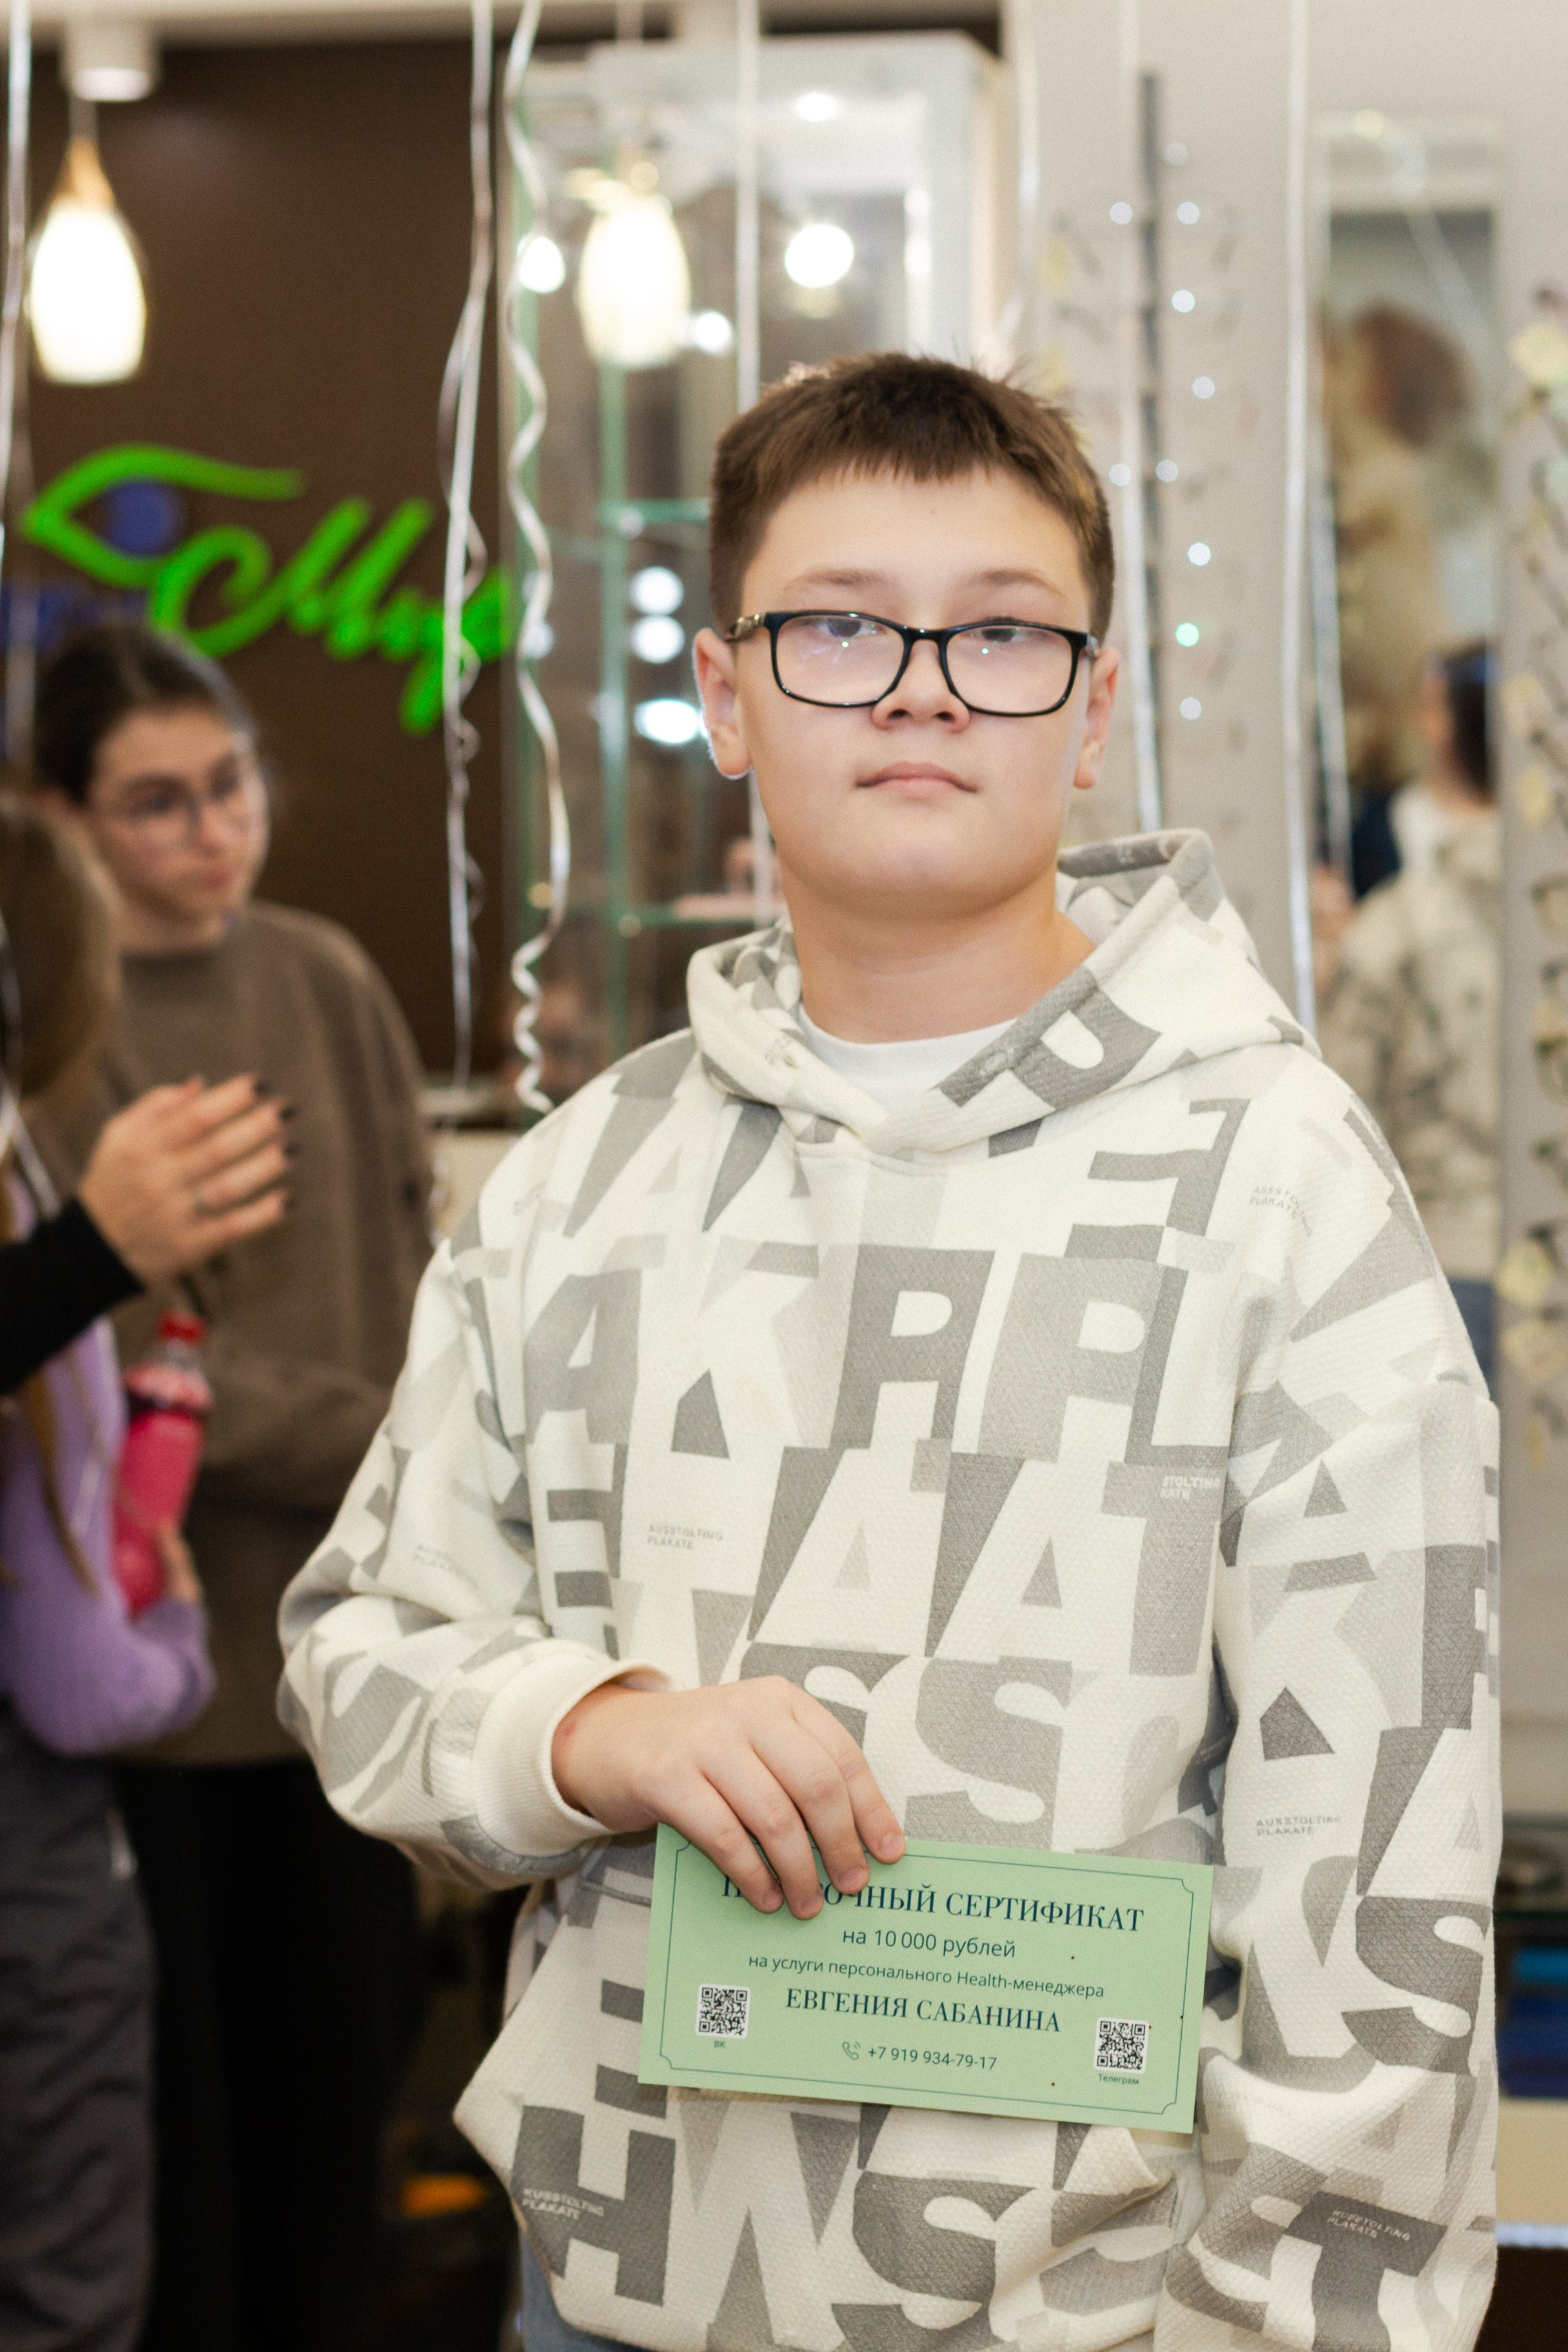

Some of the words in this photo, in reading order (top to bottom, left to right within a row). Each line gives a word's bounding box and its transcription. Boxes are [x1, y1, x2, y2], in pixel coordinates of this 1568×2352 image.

[946, 1892, 1144, 1932] СЕРТИФИКАТ
[842, 1930, 867, 1945] на
[943, 1936, 1016, 1959] рублей
[749, 1956, 768, 1968] на
[772, 1958, 824, 1974] услуги
[828, 1962, 952, 1984] персонального
[957, 1970, 1104, 2001] Health-менеджера
[785, 1987, 909, 2019] ЕВГЕНИЯ
[916, 1999, 1062, 2033] САБАНИНА
[867, 2046, 887, 2059] +7
[890, 2047, 919, 2063] 919
[923, 2050, 997, 2070] 934-79-17
[1097, 2072, 1139, 2086] Телеграм
